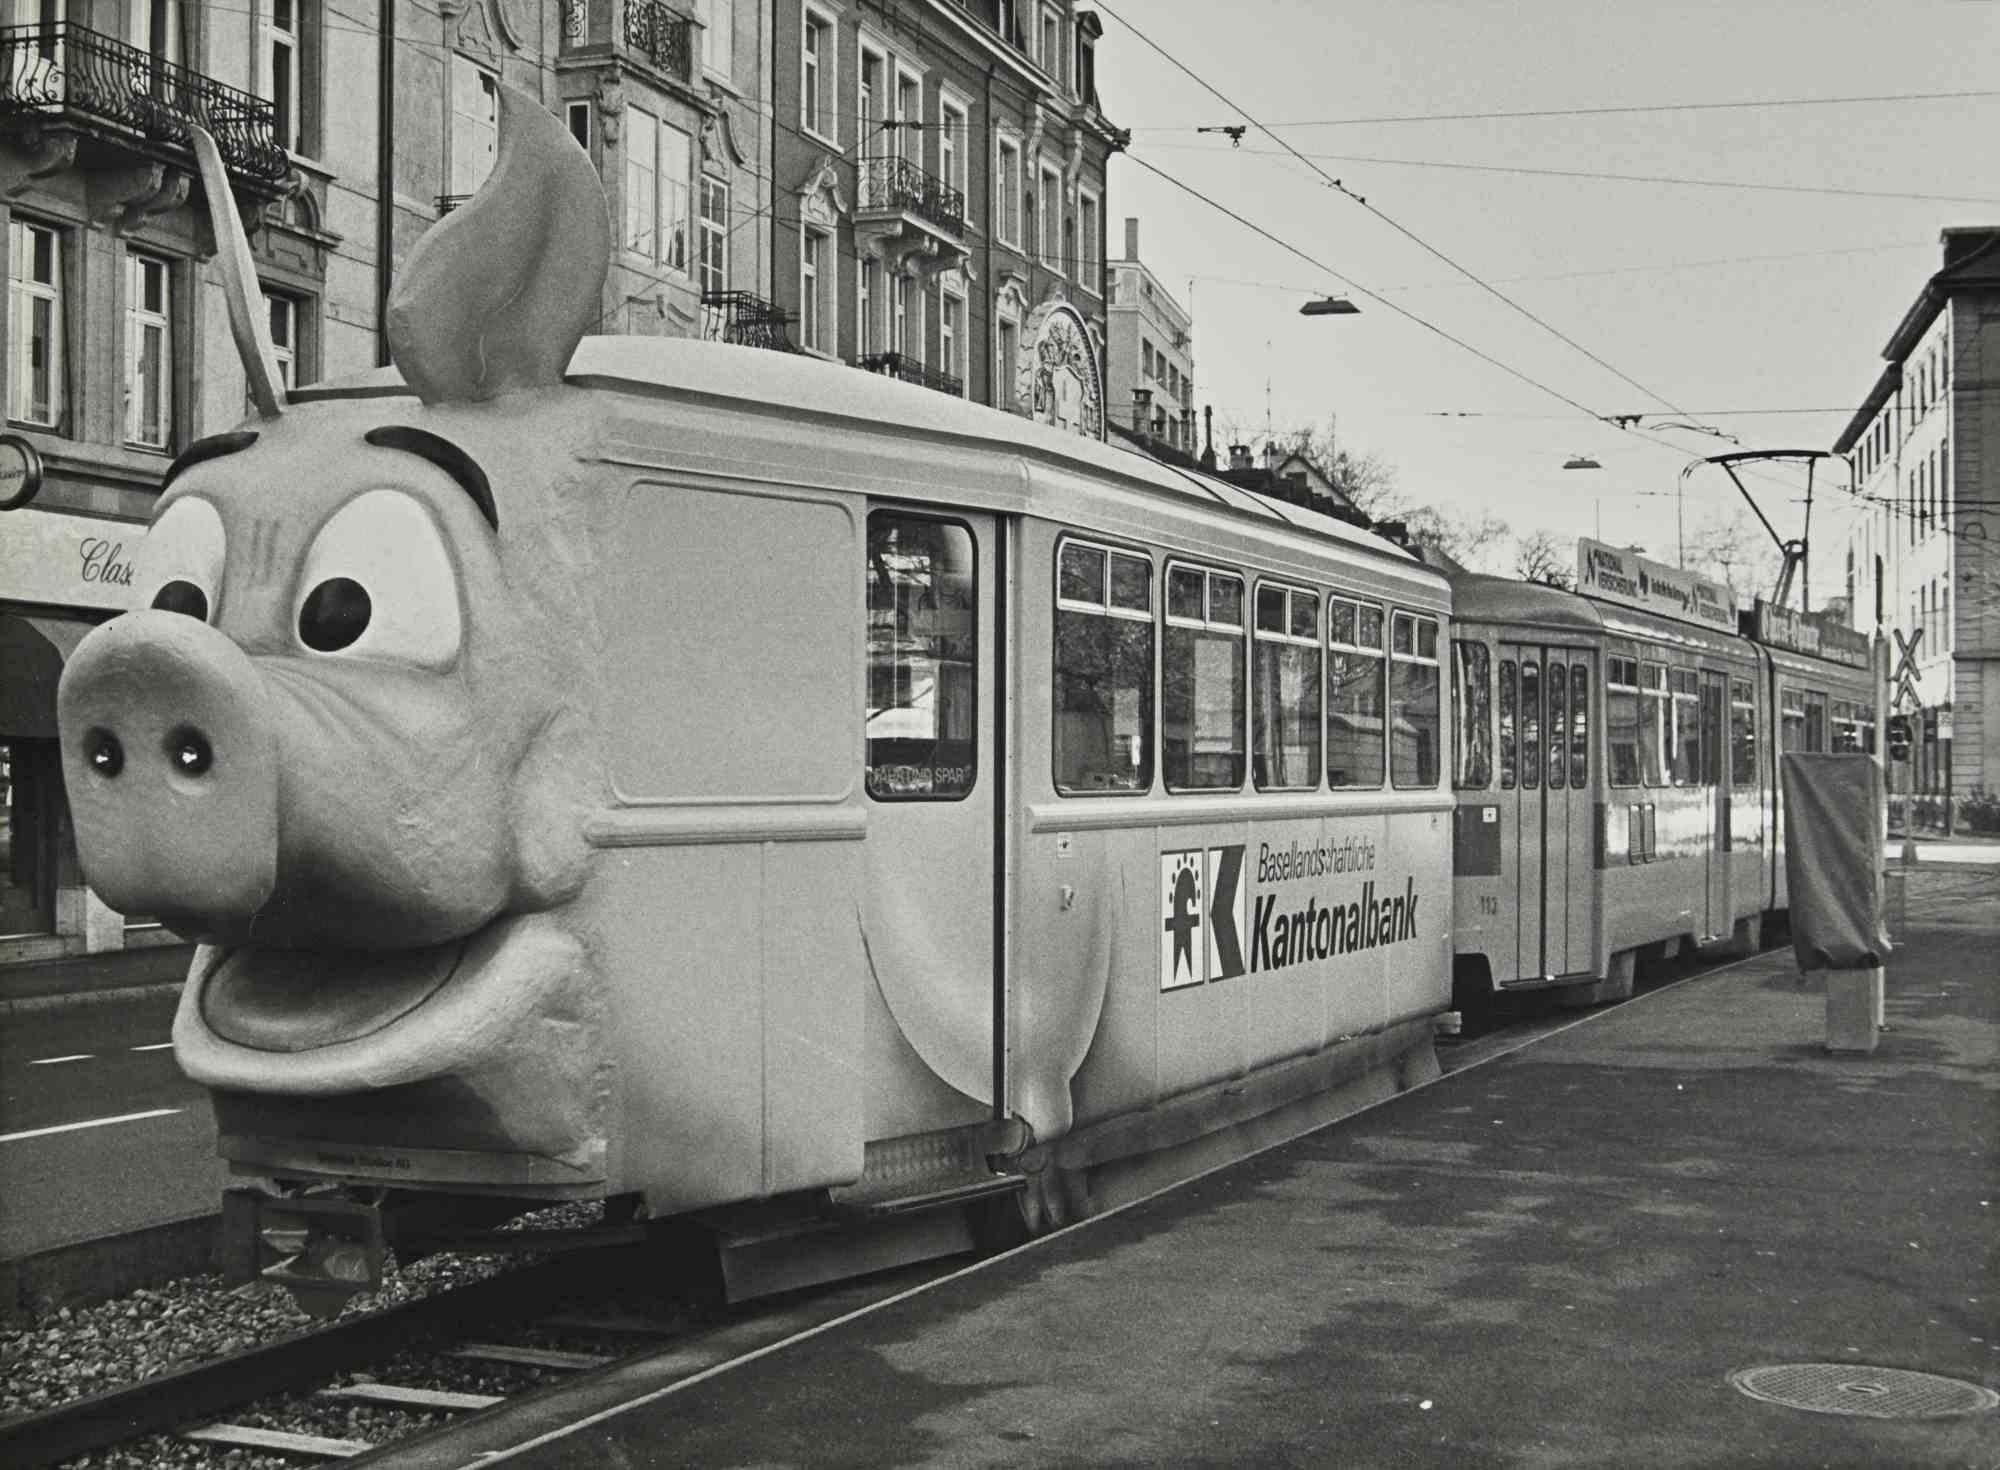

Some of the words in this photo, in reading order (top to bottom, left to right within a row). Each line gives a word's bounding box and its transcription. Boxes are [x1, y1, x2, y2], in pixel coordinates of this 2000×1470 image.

[934, 767, 965, 785] SPAR
[1257, 835, 1376, 883] Basellandschaftliche
[1250, 875, 1419, 974] Kantonalbank
